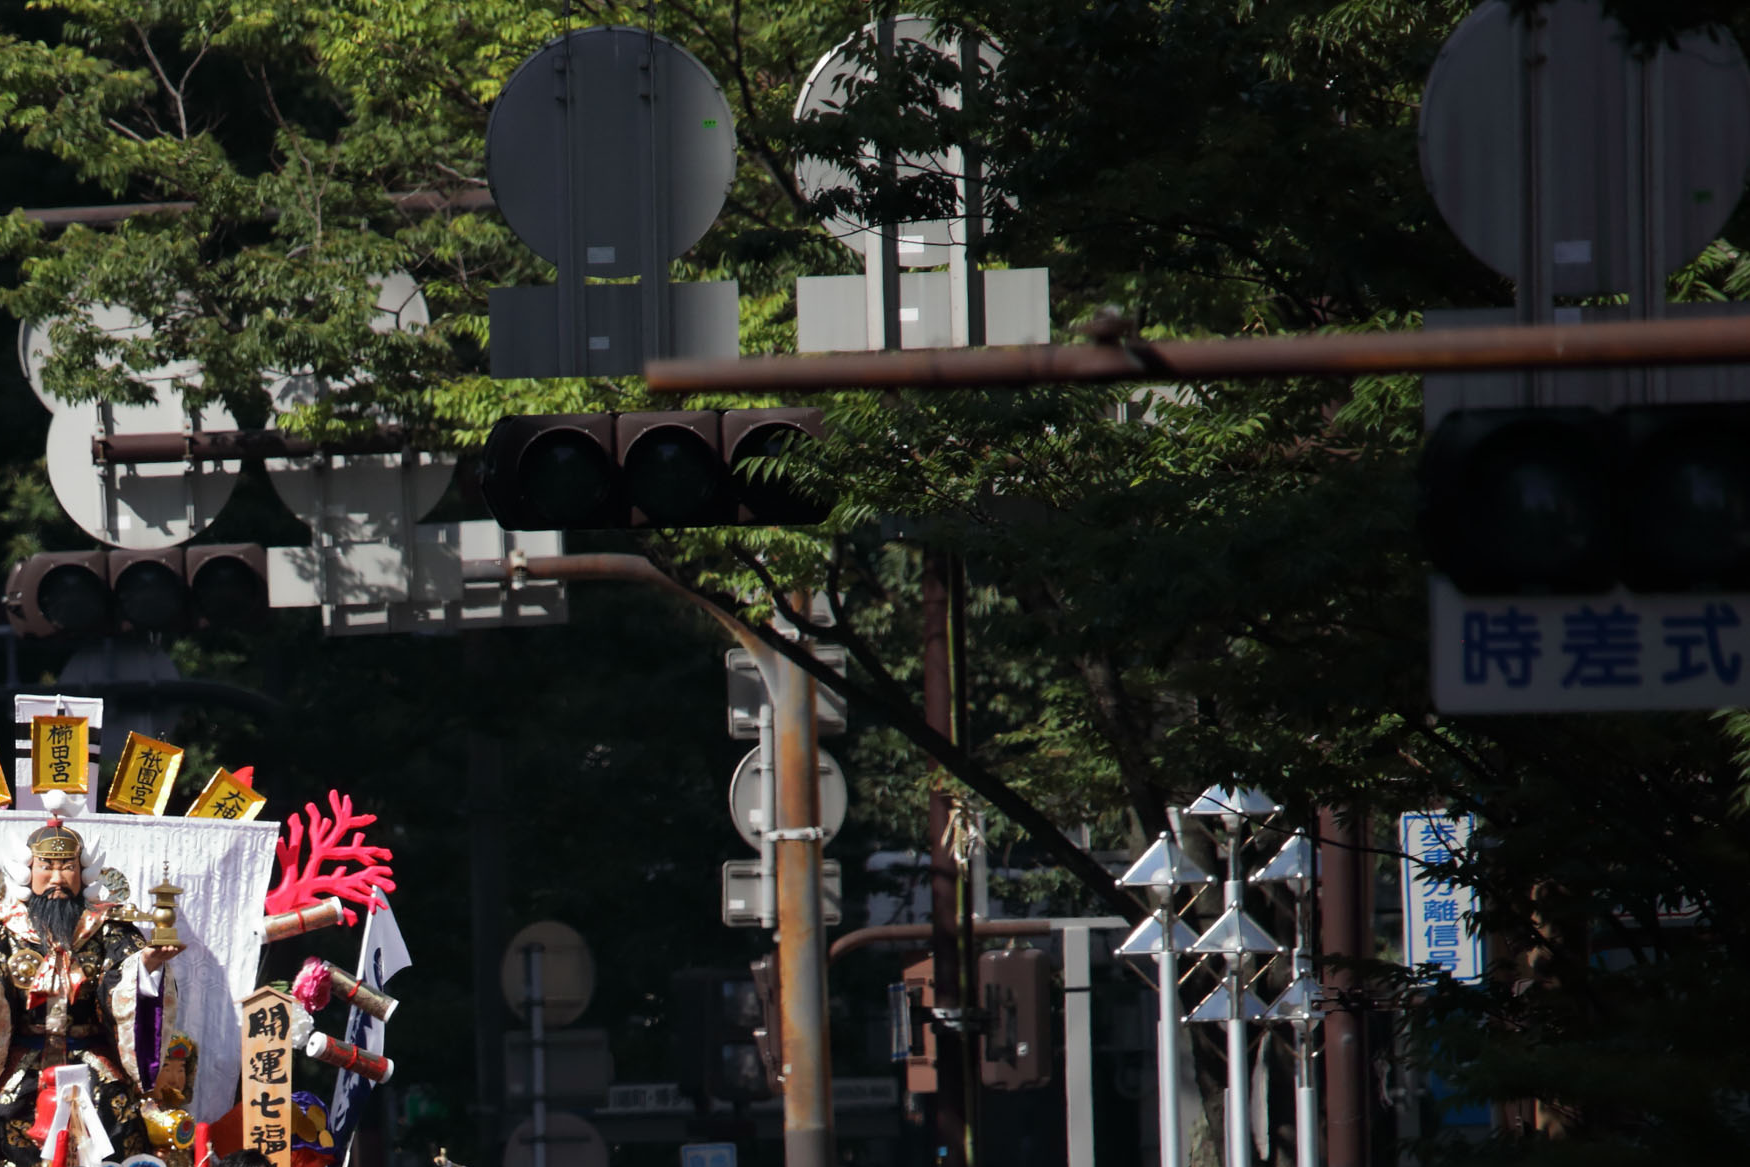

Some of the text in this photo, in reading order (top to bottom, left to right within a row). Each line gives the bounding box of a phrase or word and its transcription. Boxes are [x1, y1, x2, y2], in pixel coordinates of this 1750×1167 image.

[1462, 606, 1741, 690] 時差式
[47, 724, 73, 783] 櫛田宮
